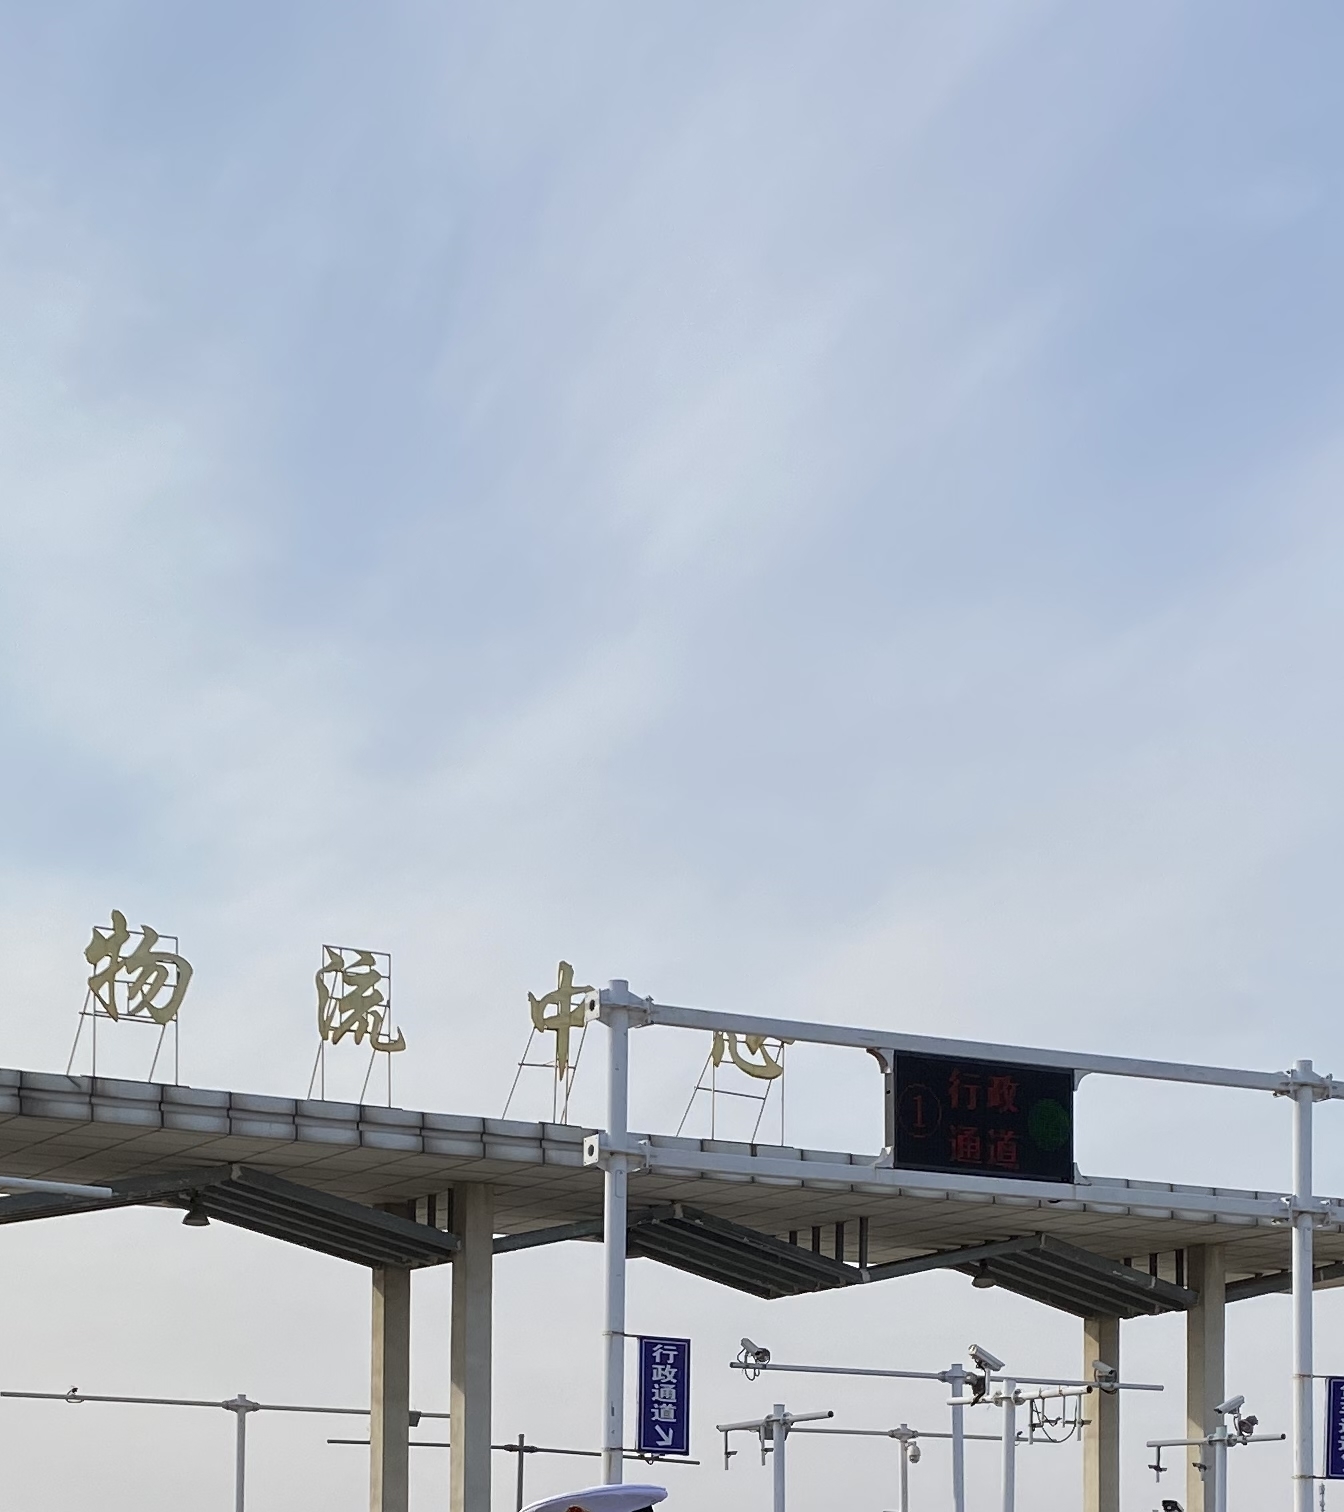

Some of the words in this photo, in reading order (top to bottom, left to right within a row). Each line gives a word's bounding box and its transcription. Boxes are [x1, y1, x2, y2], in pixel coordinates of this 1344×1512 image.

[948, 1067, 1020, 1114] 行政
[949, 1124, 1020, 1169] 通道
[650, 1344, 679, 1423] 行政通道
